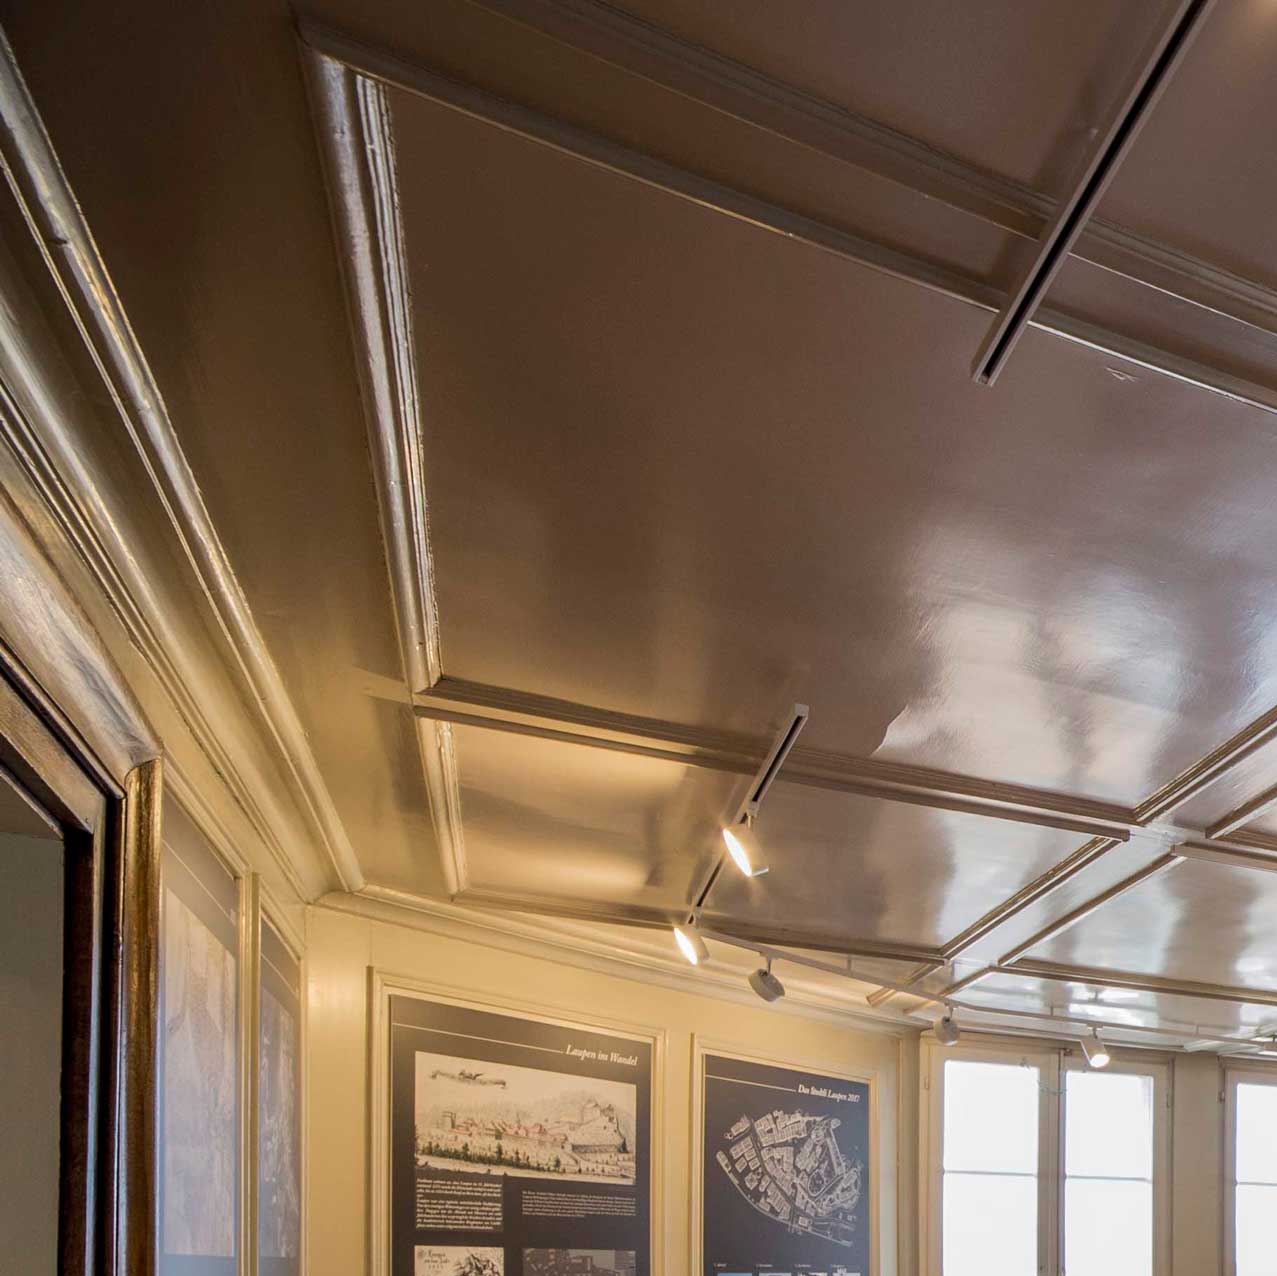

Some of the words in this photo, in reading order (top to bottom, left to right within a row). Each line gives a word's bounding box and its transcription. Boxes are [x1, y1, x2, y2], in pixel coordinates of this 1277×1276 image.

[566, 1044, 596, 1060] Laupen
[610, 1052, 638, 1066] Wandel
[828, 1089, 848, 1102] Laupen
